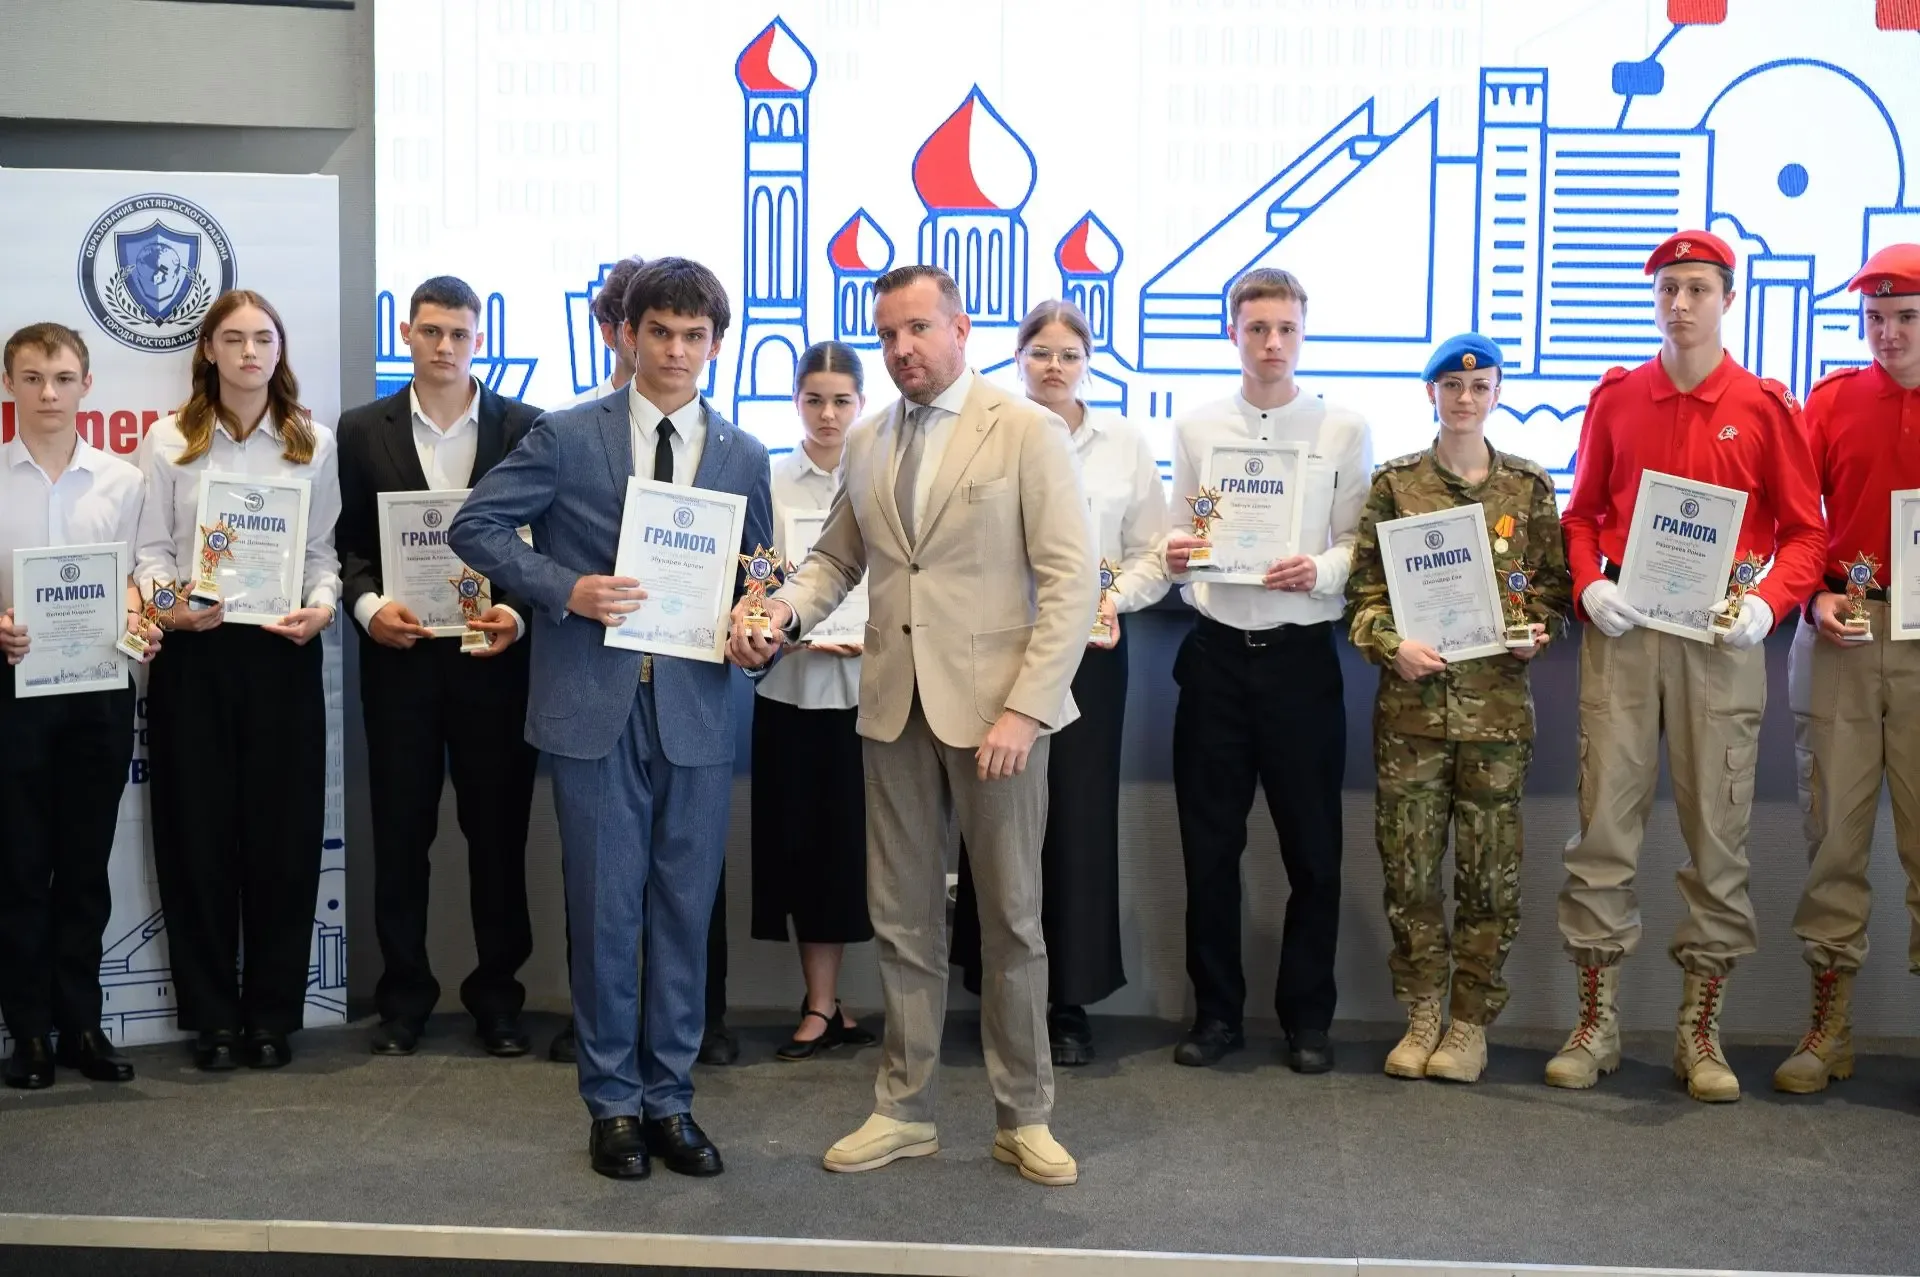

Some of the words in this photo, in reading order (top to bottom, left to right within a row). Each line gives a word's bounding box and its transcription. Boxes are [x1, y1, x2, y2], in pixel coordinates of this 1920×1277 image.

[86, 203, 135, 258] ОБРАЗОВАНИЕ
[135, 198, 207, 226] ОКТЯБРЬСКОГО
[205, 223, 230, 262] РАЙОНА
[102, 315, 135, 342] ГОРОДА
[1220, 478, 1284, 495] ГРАМОТА
[220, 512, 286, 533] ГРАМОТА
[1652, 514, 1717, 544] ГРАМОТА
[401, 530, 450, 546] ГРАМО
[644, 526, 716, 555] ГРАМОТА
[1405, 547, 1472, 573] ГРАМОТА
[36, 584, 105, 603] ГРАМОТА
